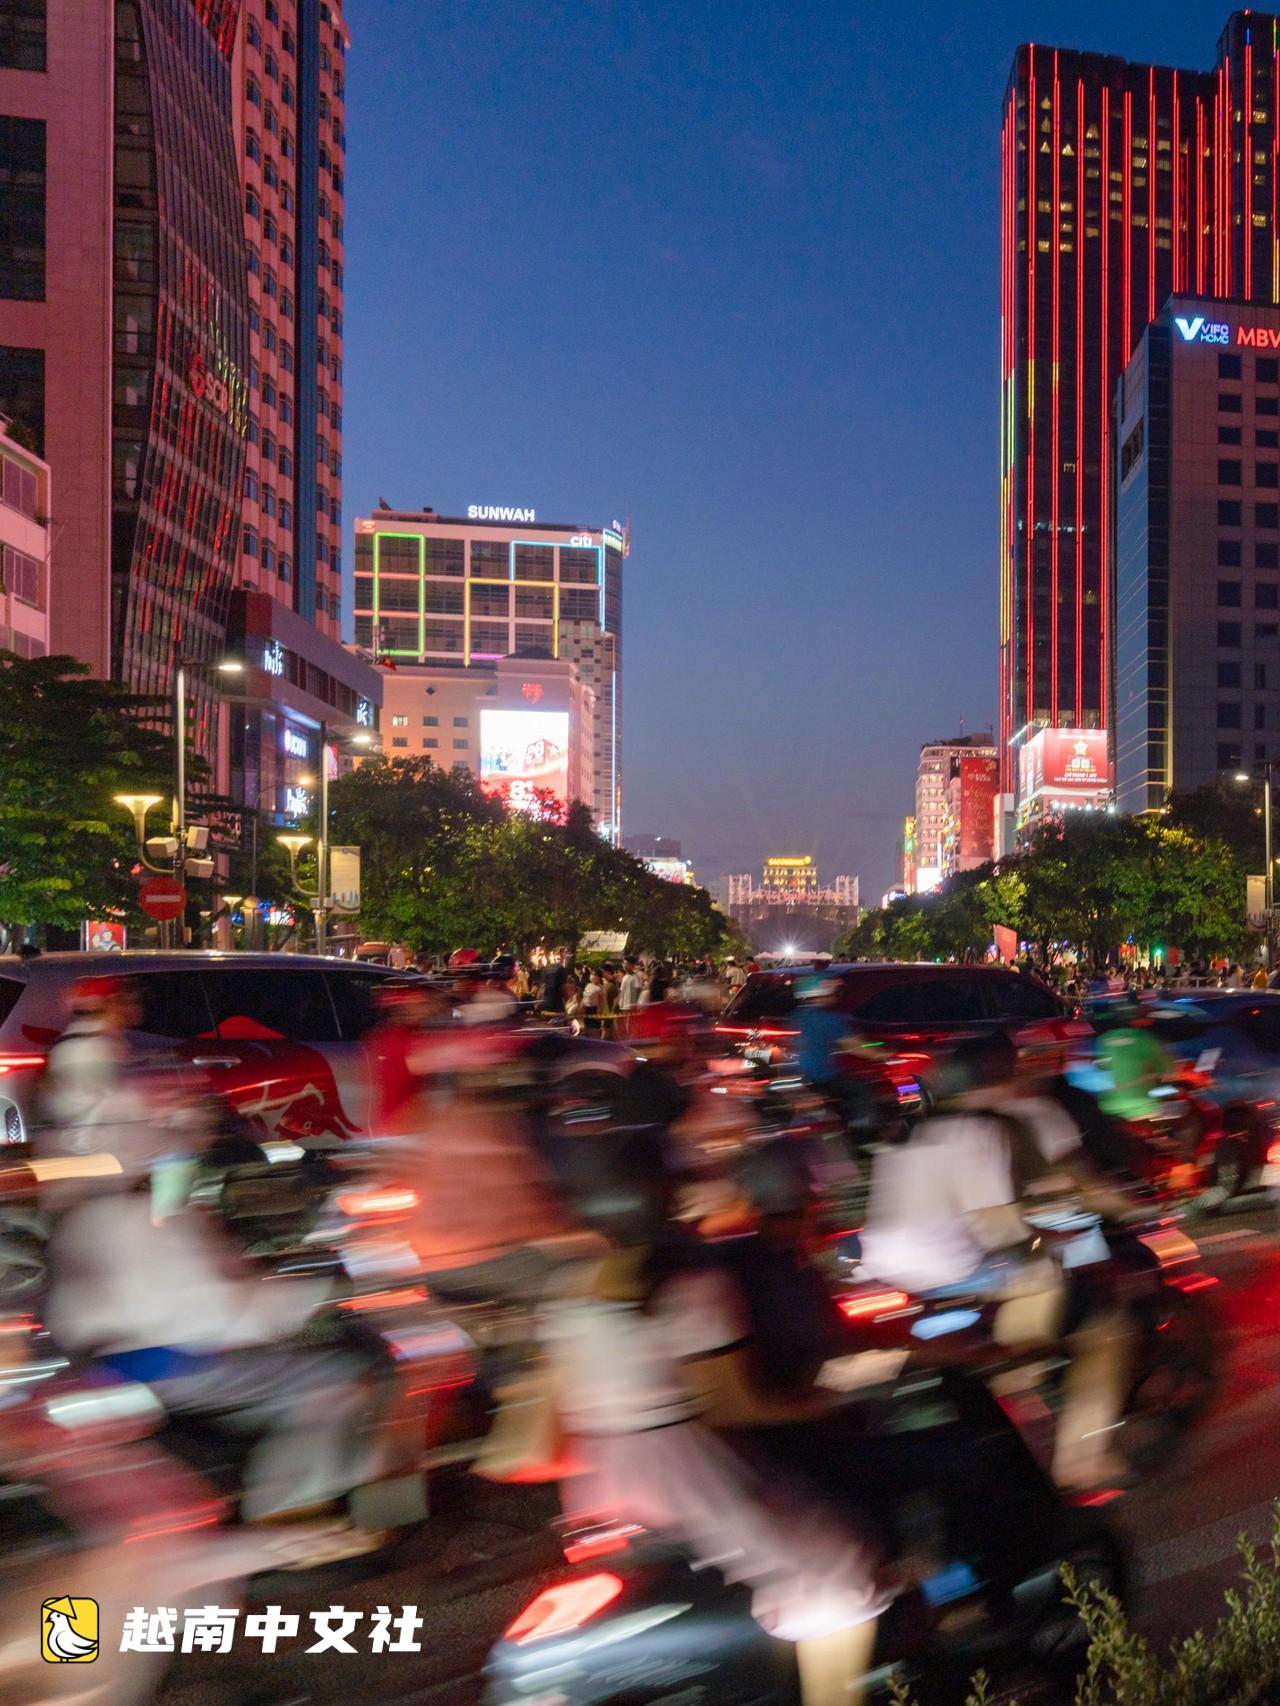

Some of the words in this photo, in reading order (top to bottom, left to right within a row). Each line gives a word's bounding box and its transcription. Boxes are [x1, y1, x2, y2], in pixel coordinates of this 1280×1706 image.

[1201, 323, 1229, 335] VIFC
[1200, 333, 1229, 345] HCMC
[467, 505, 535, 522] SUNWAH
[570, 536, 592, 547] citi
